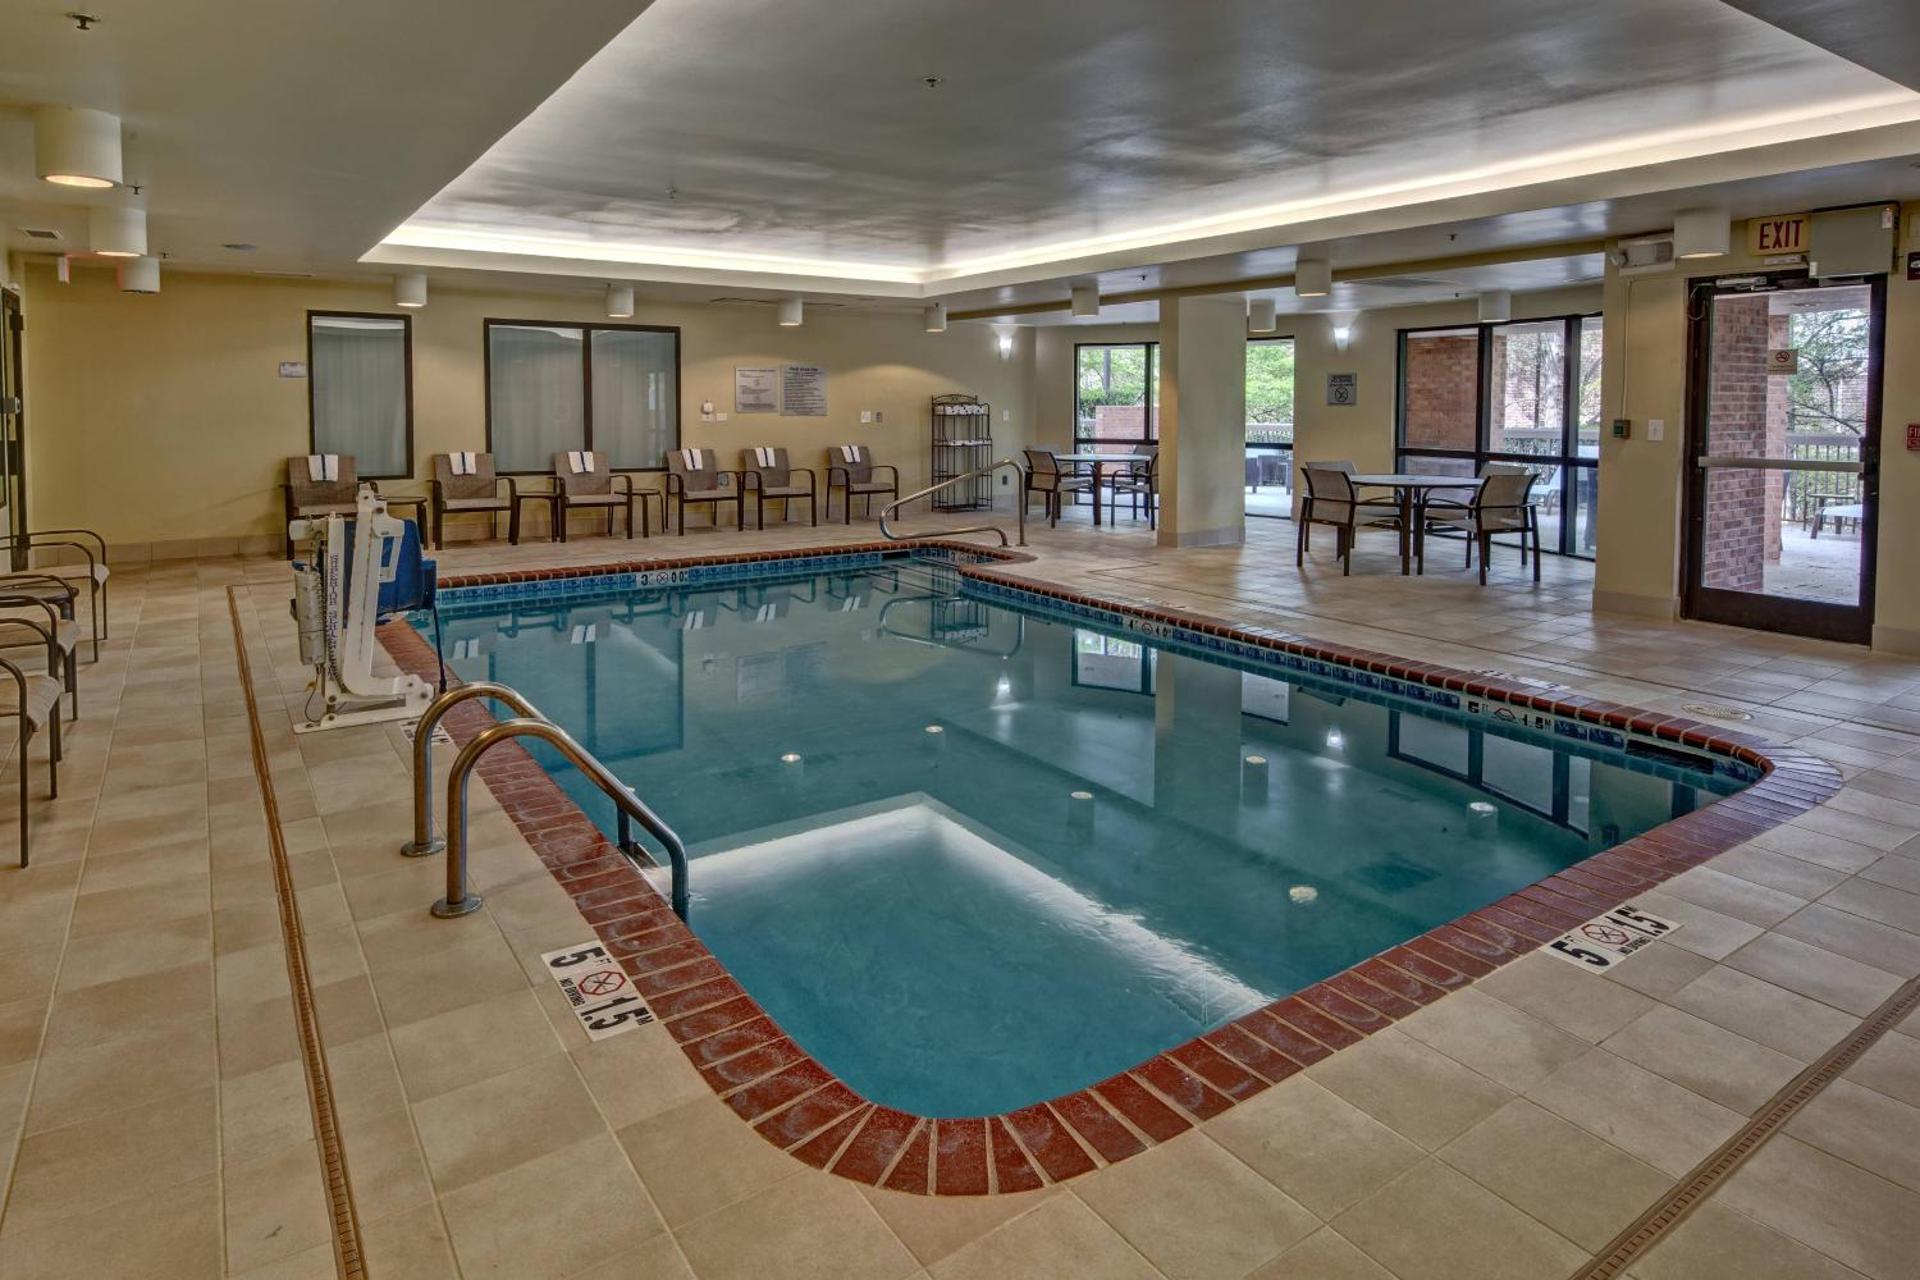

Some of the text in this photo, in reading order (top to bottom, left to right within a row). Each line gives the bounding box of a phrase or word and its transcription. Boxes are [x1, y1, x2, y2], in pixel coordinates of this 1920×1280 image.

[1758, 219, 1804, 251] EXIT
[641, 573, 649, 586] 3
[550, 946, 606, 968] 5
[1550, 940, 1611, 967] 5
[580, 996, 650, 1031] 1.5
